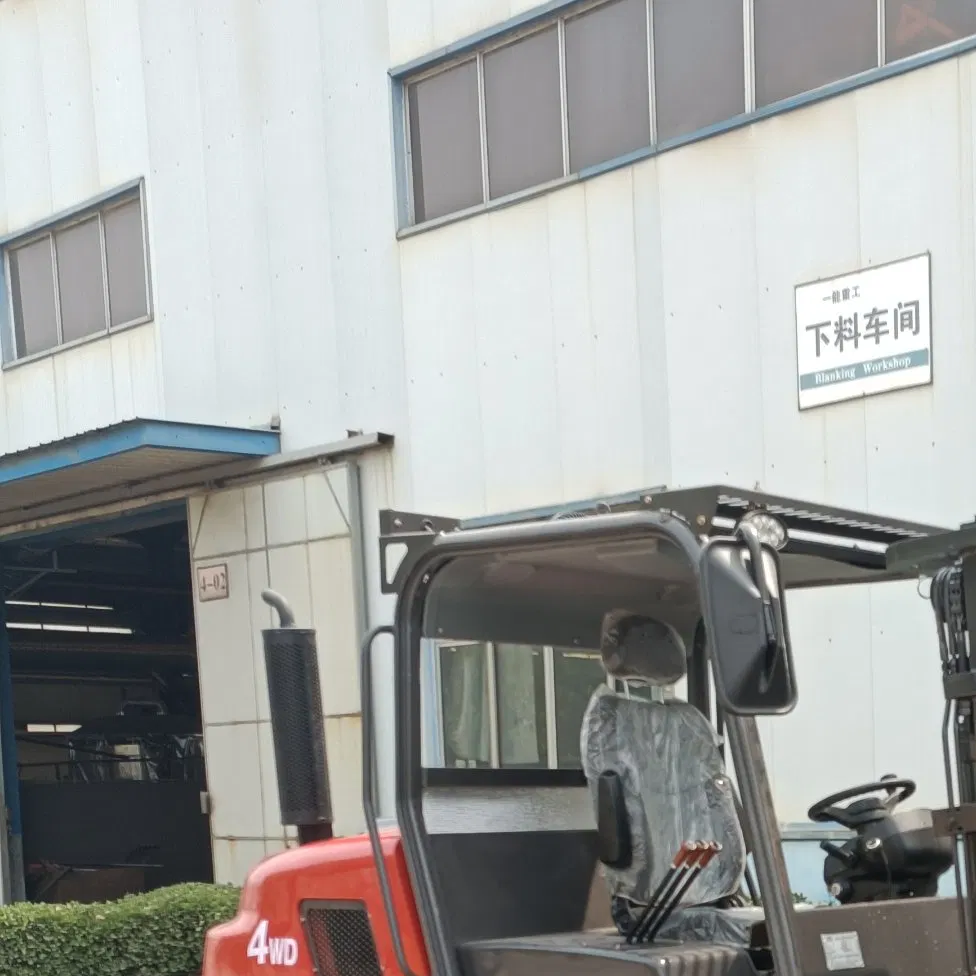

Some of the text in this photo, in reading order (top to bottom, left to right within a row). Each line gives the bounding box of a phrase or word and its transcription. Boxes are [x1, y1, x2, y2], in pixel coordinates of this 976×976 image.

[805, 300, 920, 358] 下料车间
[815, 355, 912, 385] Blanking Workshop
[246, 919, 299, 966] 4WD
